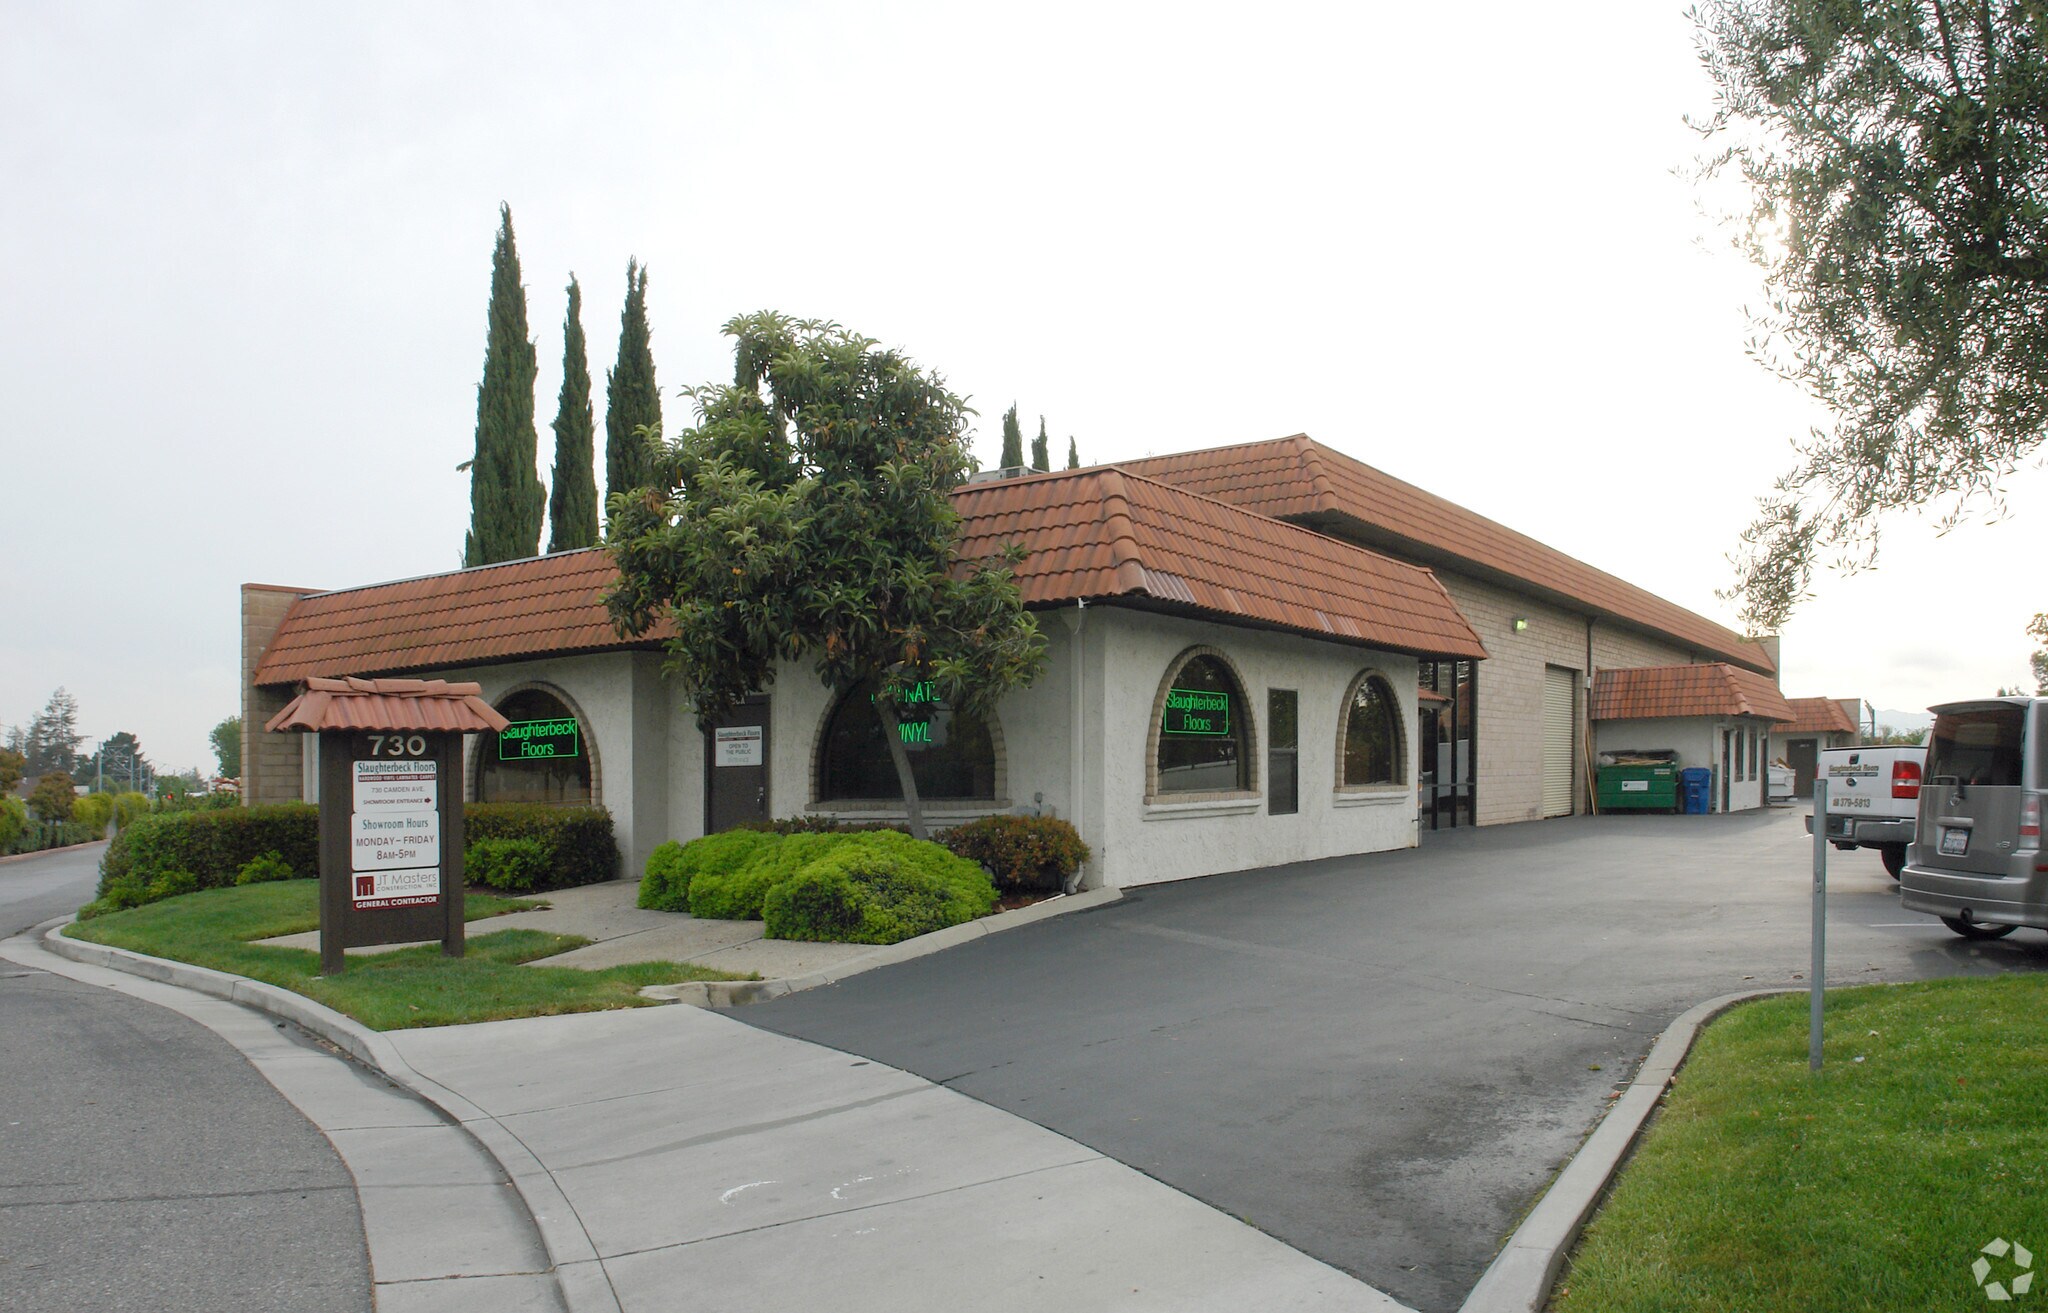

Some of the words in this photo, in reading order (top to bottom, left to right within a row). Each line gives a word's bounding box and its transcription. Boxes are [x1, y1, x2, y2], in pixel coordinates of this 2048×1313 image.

[1166, 692, 1226, 713] Slaughterbeck
[1184, 714, 1211, 731] Floors
[367, 735, 426, 755] 730
[522, 742, 554, 756] Floors
[358, 762, 412, 774] Slaughterbeck
[413, 762, 436, 772] Floors
[362, 819, 404, 830] Showroom
[406, 818, 429, 828] Hours
[356, 837, 395, 847] MONDAY
[403, 835, 435, 845] FRIDAY
[376, 849, 416, 860] 8AM-5PM
[376, 875, 389, 886] JT
[391, 873, 437, 885] Masters
[355, 900, 389, 908] GENERAL
[390, 896, 437, 906] CONTRACTOR
